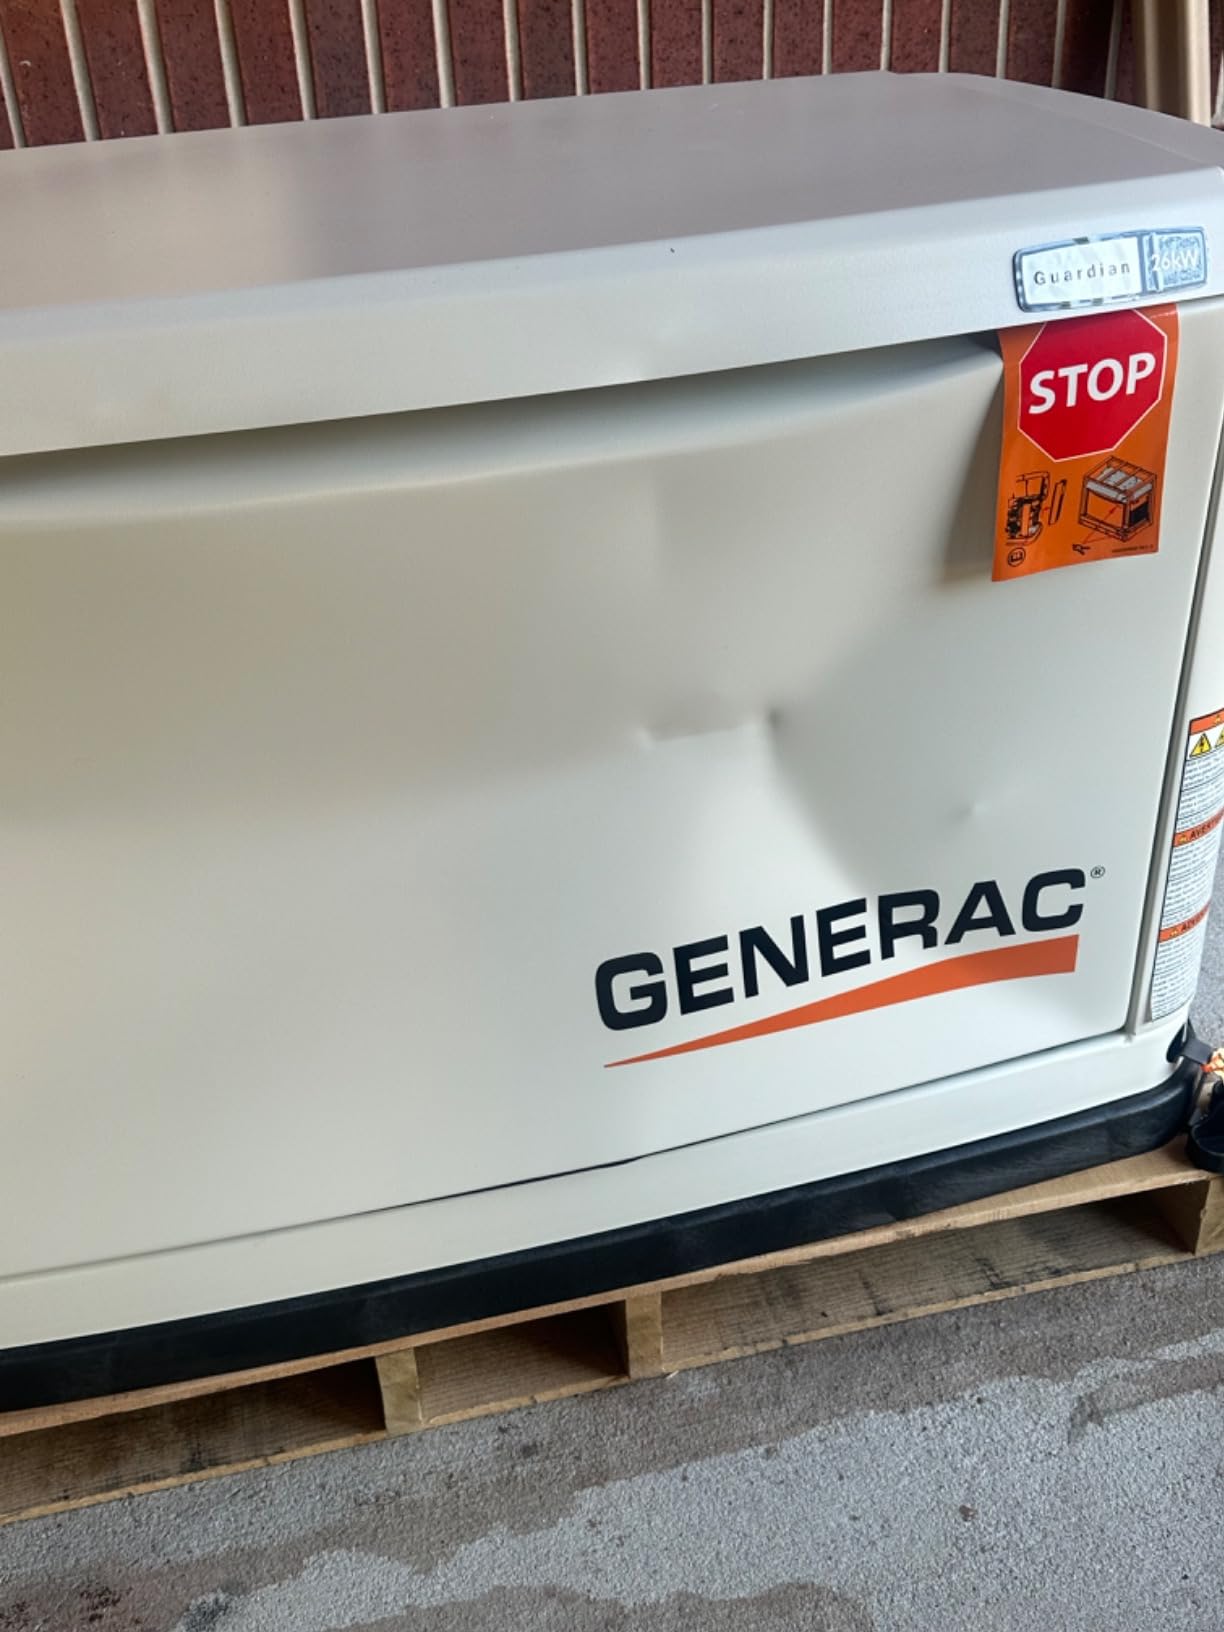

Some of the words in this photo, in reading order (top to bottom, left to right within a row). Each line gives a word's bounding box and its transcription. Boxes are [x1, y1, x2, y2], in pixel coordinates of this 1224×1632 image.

[1151, 250, 1198, 273] 26kW
[1033, 262, 1131, 286] Guardian
[1028, 352, 1157, 415] STOP
